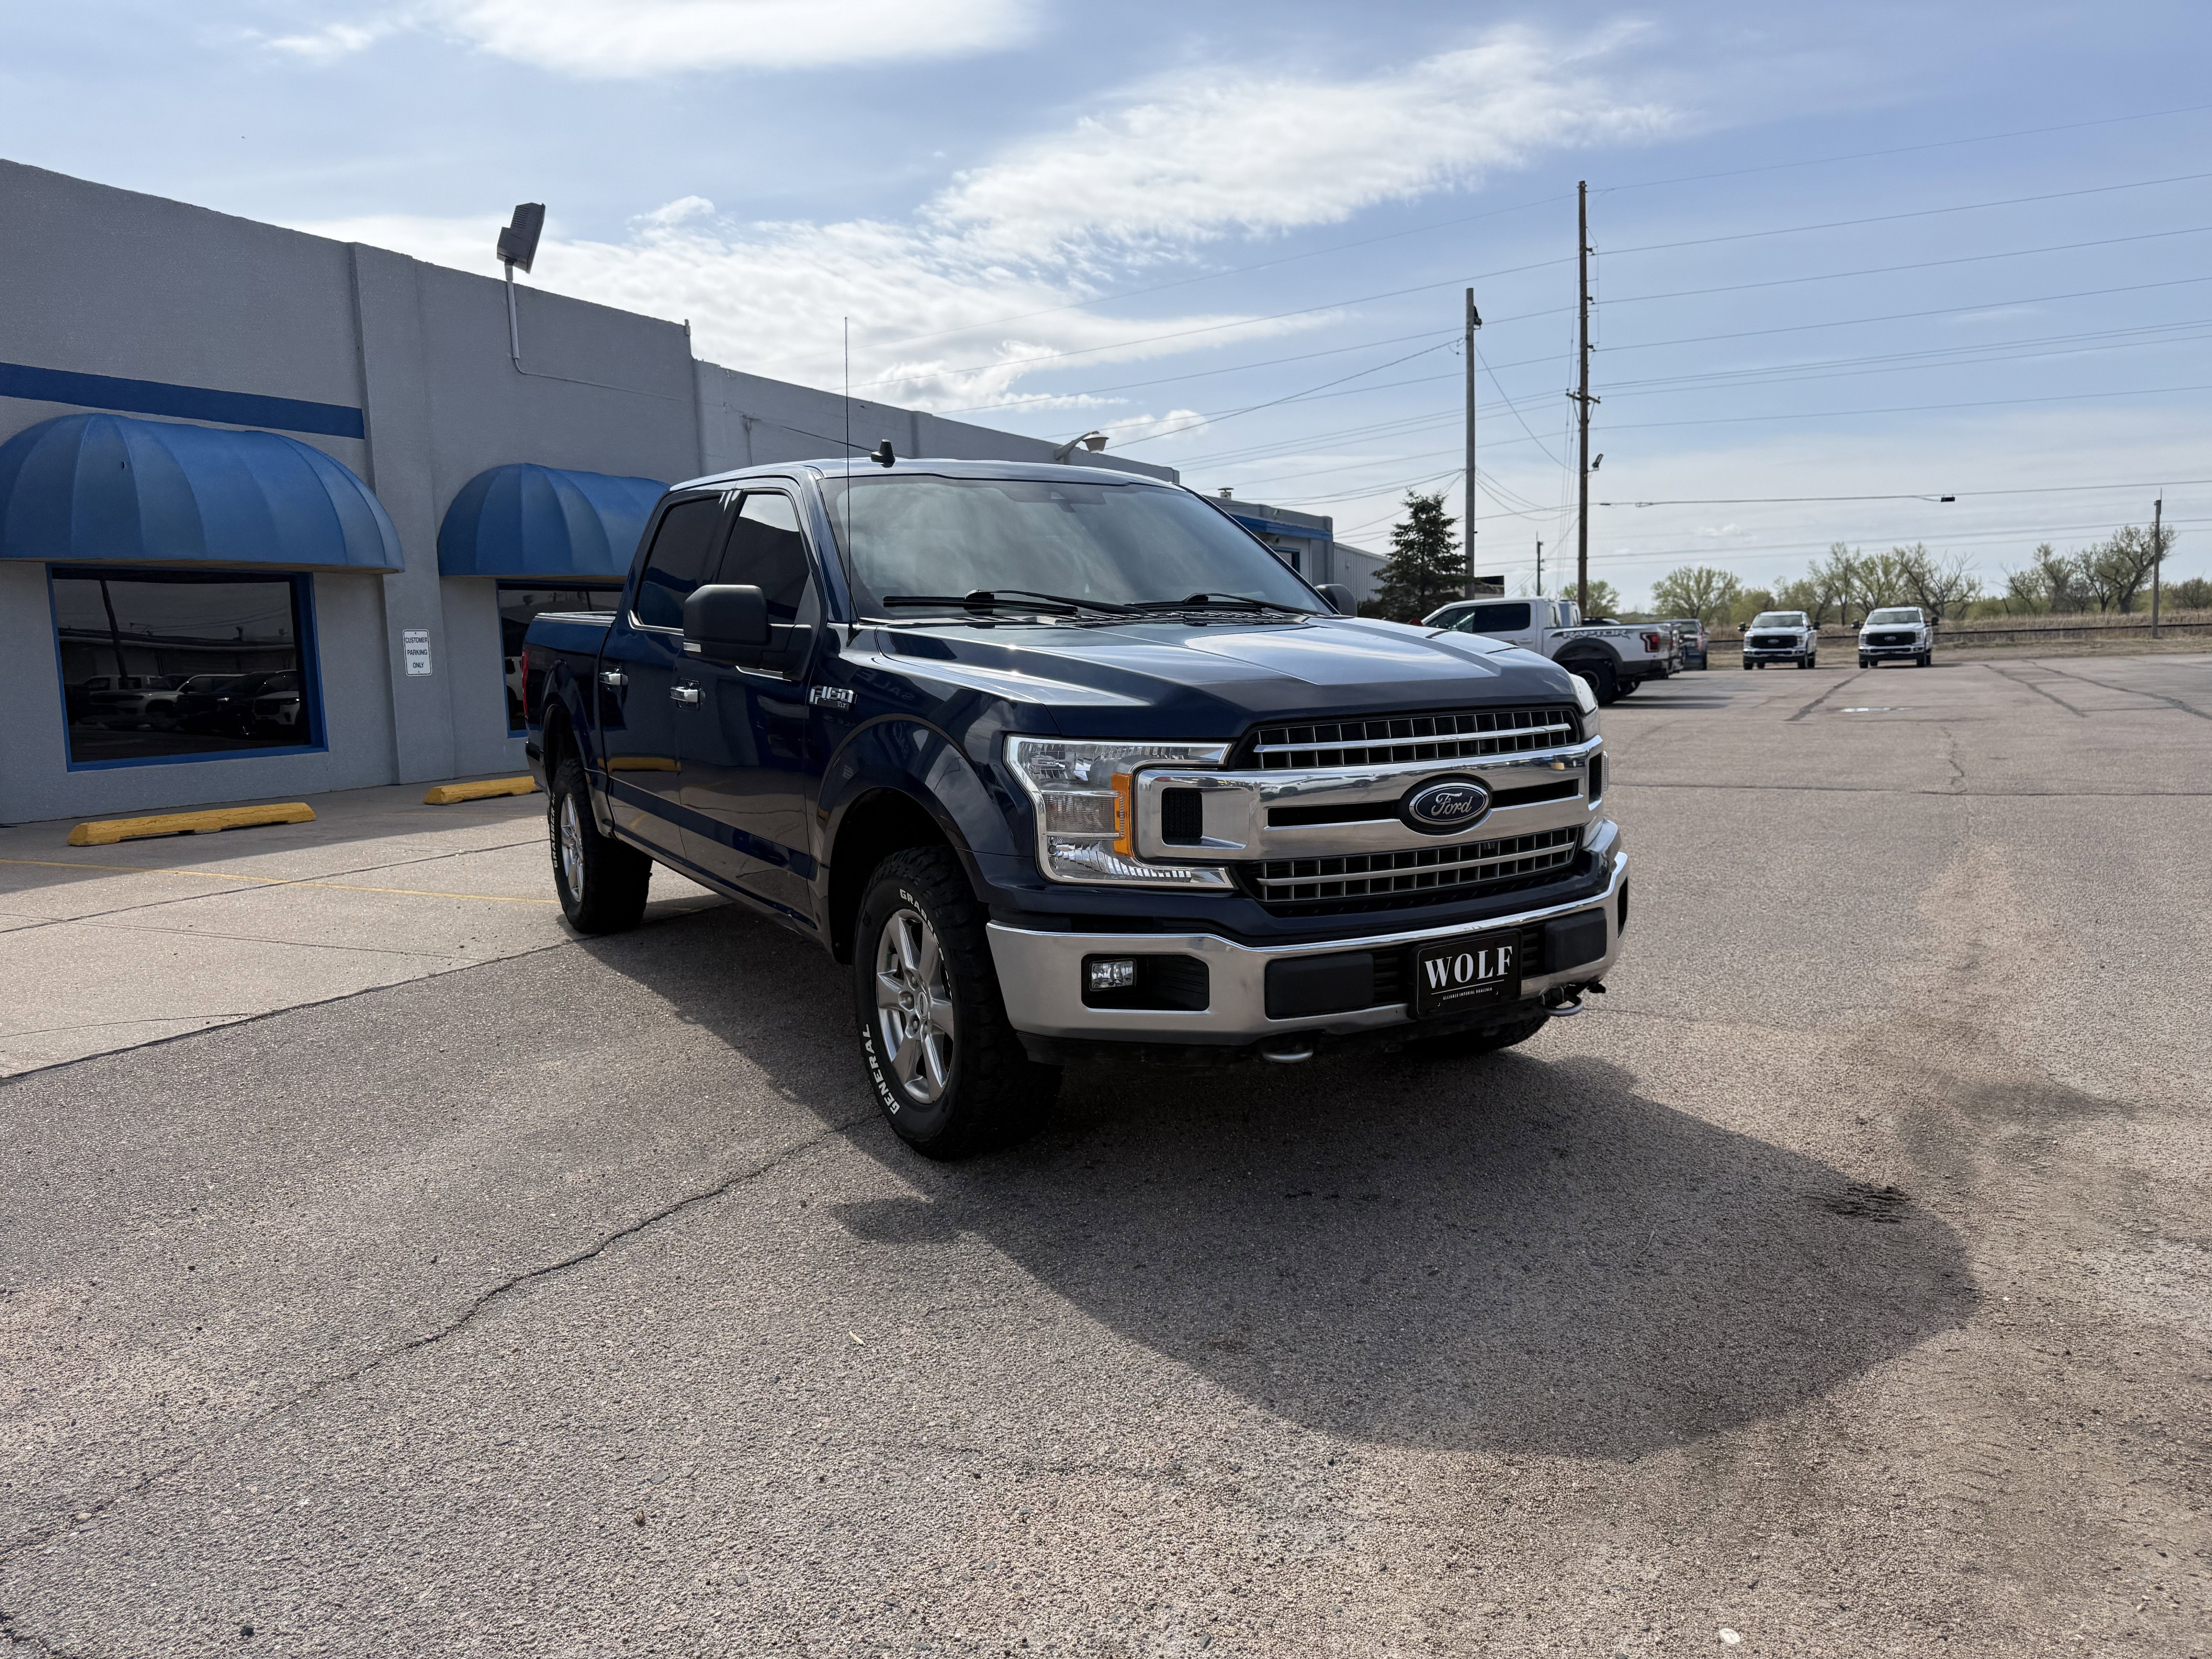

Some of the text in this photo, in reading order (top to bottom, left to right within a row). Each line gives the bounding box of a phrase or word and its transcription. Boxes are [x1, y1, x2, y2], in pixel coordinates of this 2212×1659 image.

[1563, 629, 1630, 639] RAPTOR
[1431, 792, 1473, 816] Ford
[1424, 946, 1513, 989] WOLF
[862, 1024, 900, 1115] GENERAL
